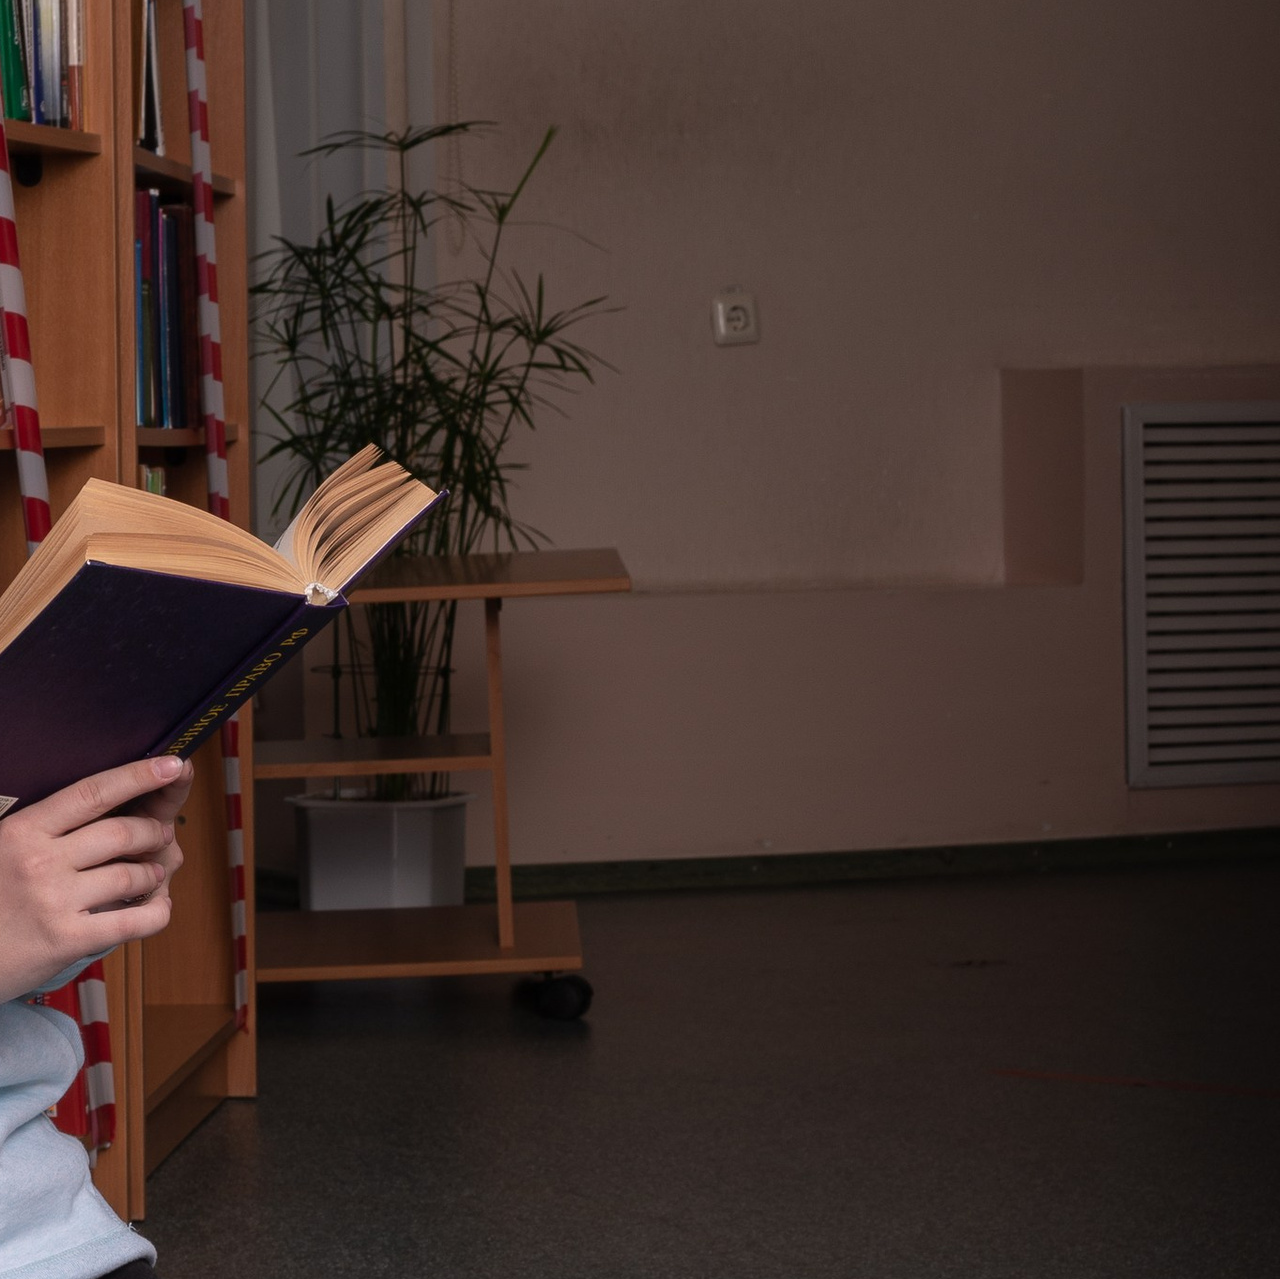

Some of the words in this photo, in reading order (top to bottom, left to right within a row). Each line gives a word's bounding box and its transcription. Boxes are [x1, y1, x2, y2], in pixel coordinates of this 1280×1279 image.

[163, 703, 229, 756] ВЕННОЕ
[224, 652, 282, 698] ПРАВО
[279, 627, 308, 647] РФ
